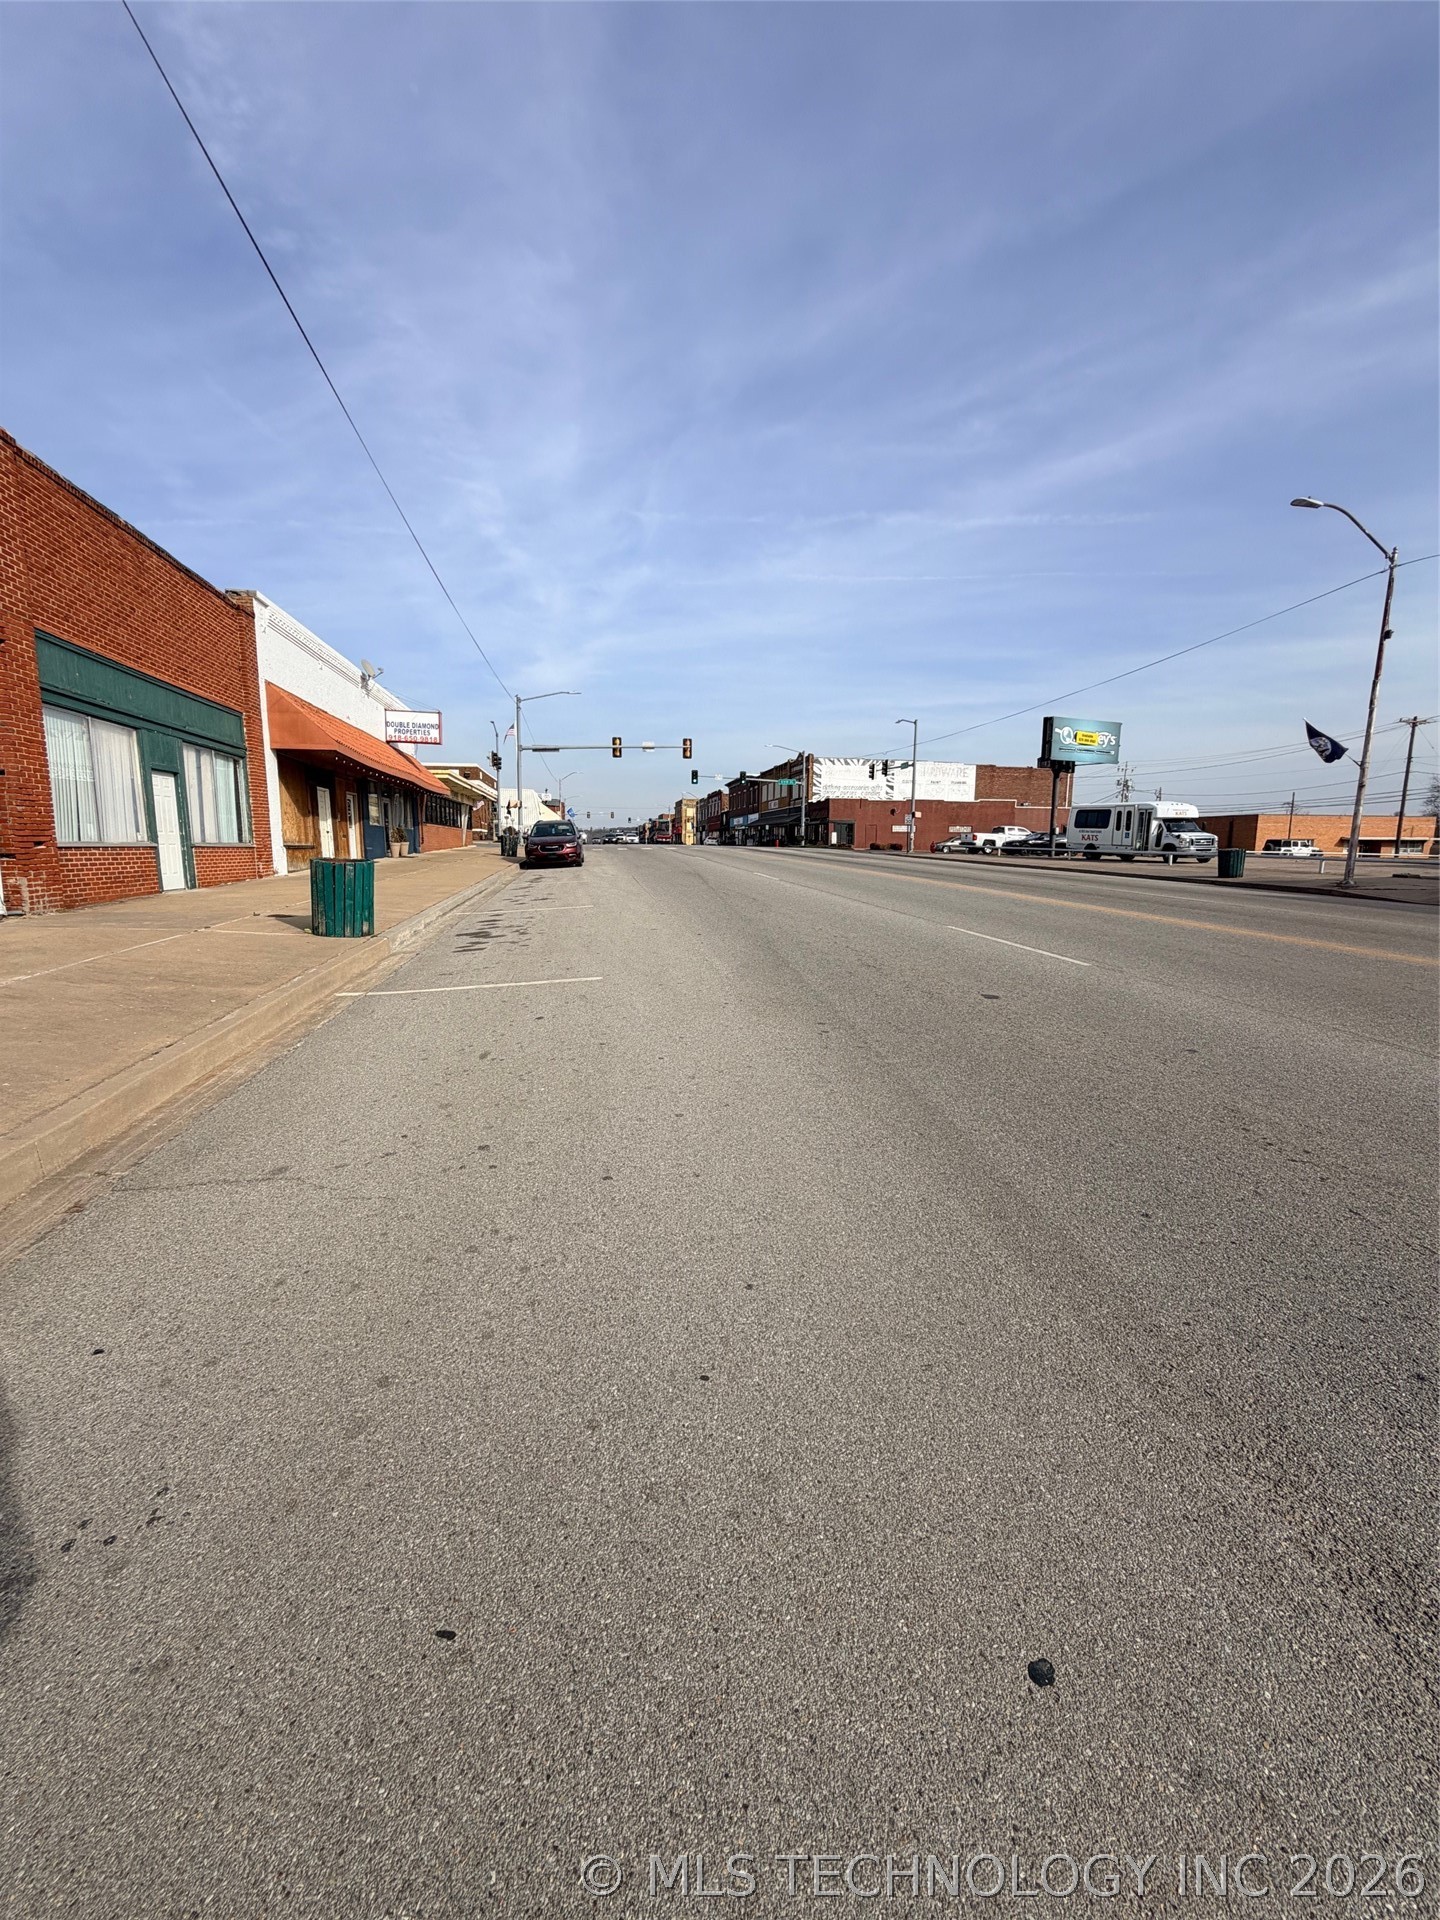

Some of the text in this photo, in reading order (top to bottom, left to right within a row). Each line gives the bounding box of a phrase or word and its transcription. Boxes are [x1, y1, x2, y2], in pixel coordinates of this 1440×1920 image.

[412, 722, 439, 730] DIAMOND
[394, 728, 430, 736] PROPERTIES
[1081, 834, 1099, 842] KATS
